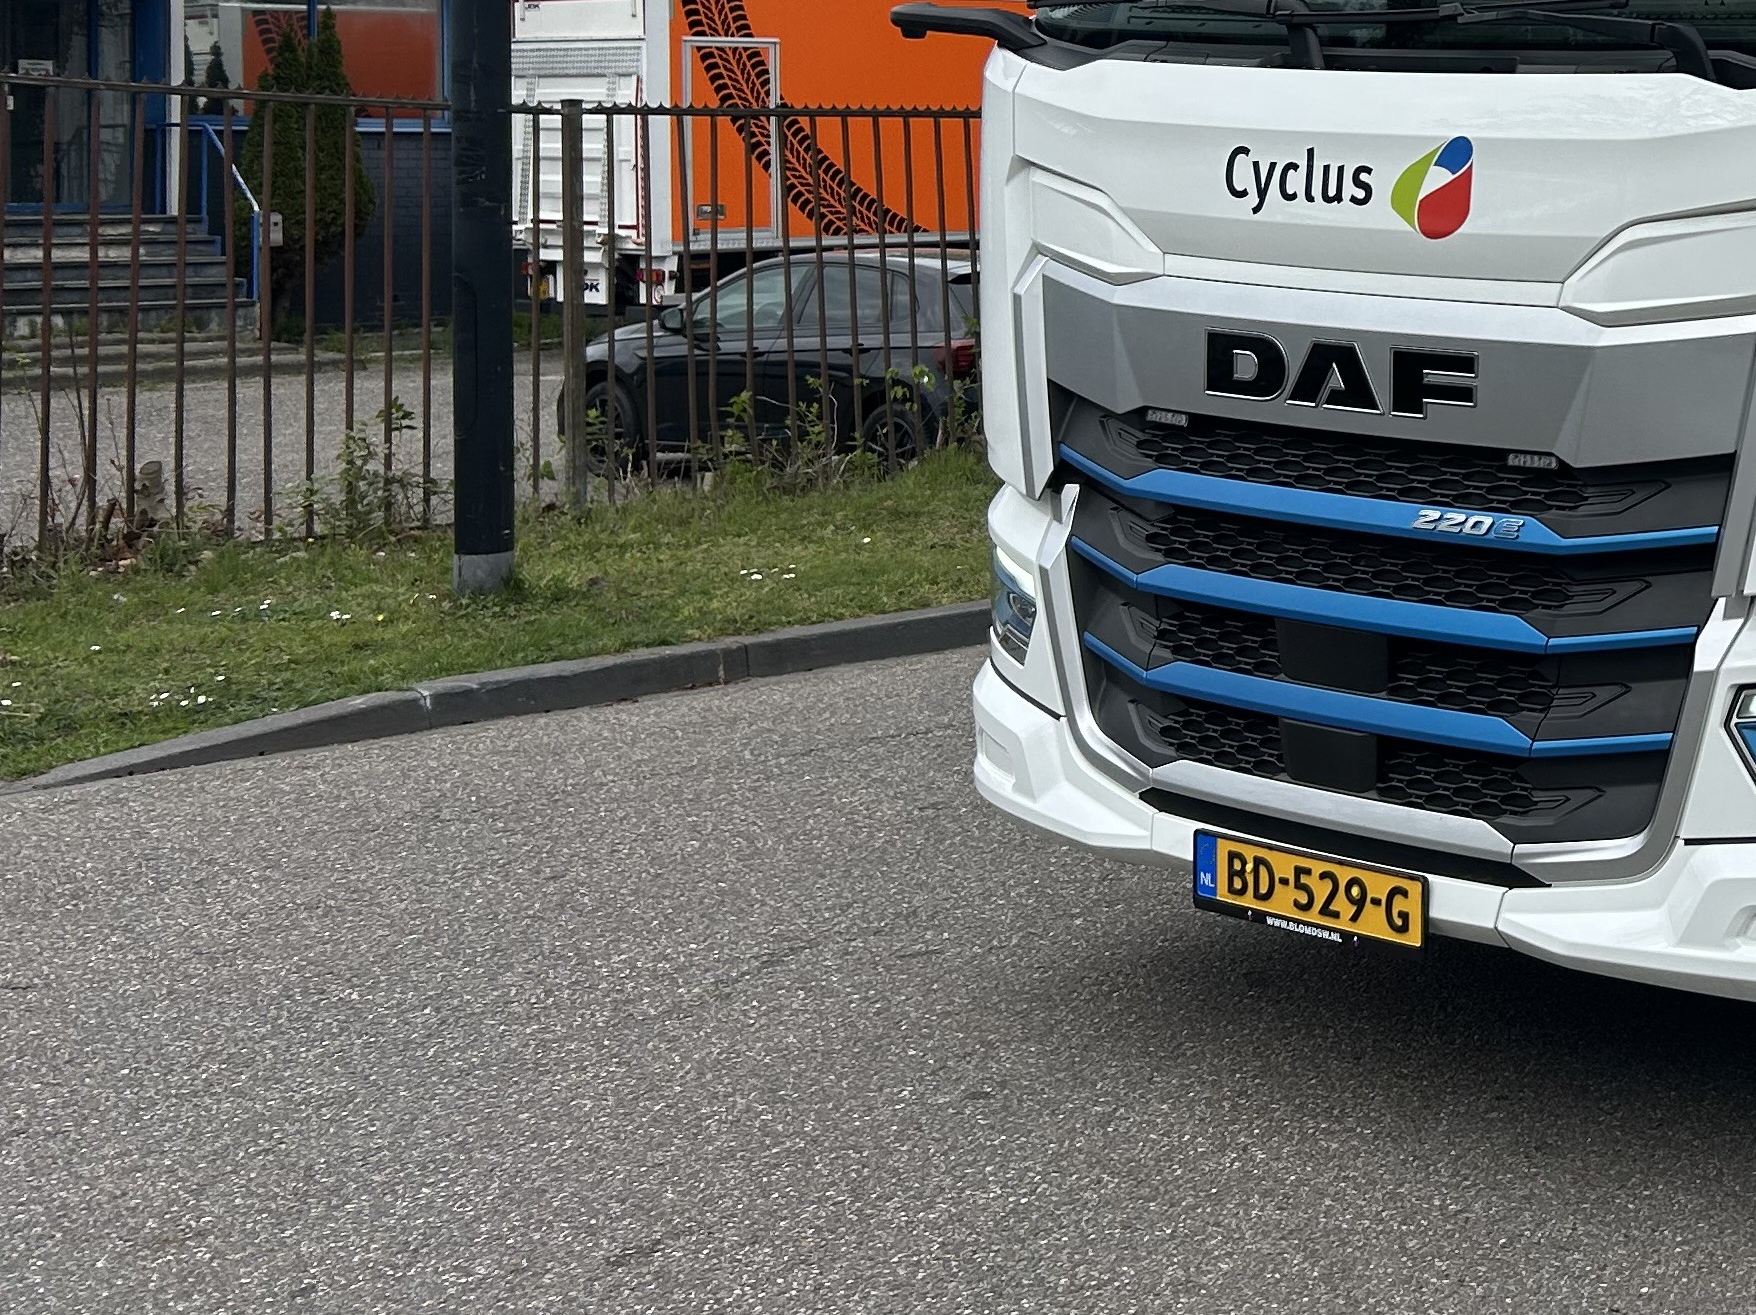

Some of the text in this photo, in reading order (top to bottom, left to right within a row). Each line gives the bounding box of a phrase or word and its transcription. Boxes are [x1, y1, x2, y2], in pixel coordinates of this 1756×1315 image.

[1225, 145, 1374, 215] Cyclus
[1204, 327, 1480, 420] DAF
[1200, 849, 1410, 934] NL BD-529-G
